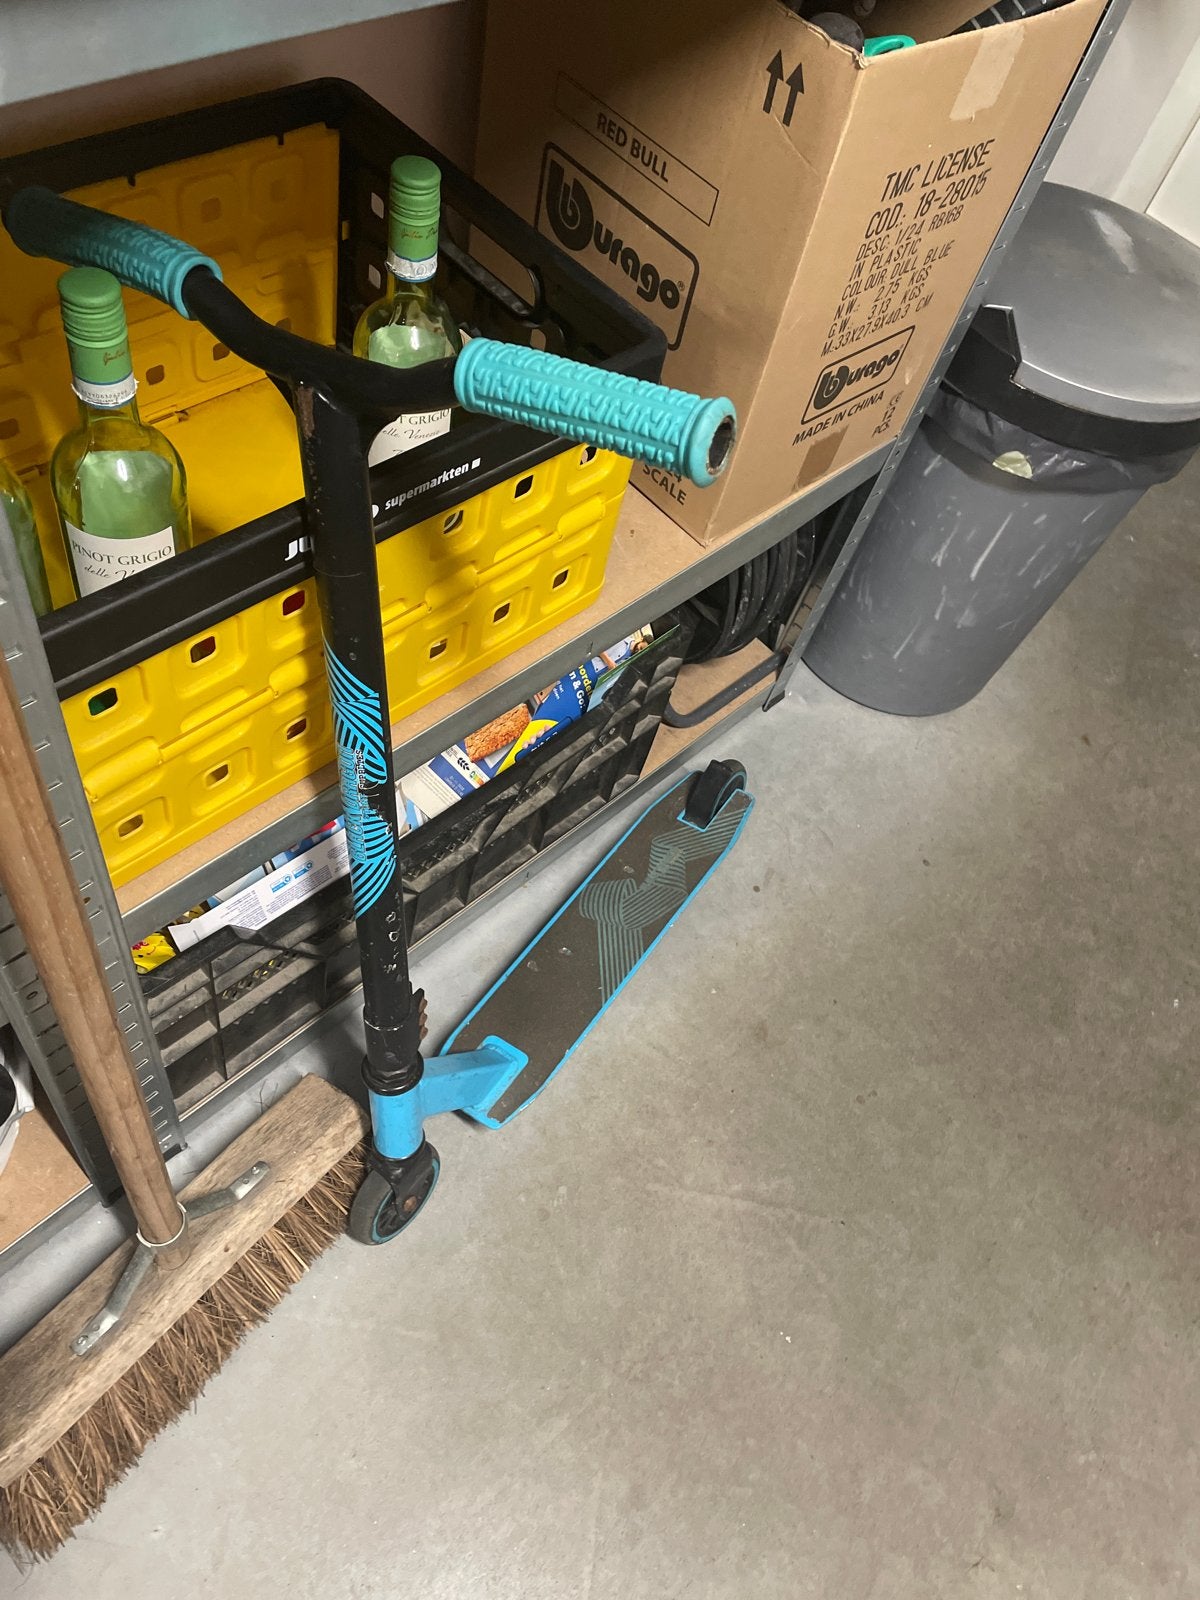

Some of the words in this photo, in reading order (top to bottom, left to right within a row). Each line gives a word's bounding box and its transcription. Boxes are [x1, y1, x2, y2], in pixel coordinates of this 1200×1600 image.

[596, 112, 628, 148] RED
[629, 137, 669, 183] BULL
[880, 164, 921, 202] TMC
[920, 138, 996, 189] LICENSE
[914, 167, 992, 220] 18-28015
[895, 219, 925, 246] 1/24
[849, 260, 865, 282] IN
[869, 238, 922, 273] PLASTIC
[890, 255, 918, 280] DULL
[923, 239, 956, 266] BLUE
[868, 298, 892, 321] 3.13
[901, 282, 925, 305] KGS
[874, 277, 903, 303] 2.75
[908, 264, 932, 287] KGS
[915, 291, 935, 313] CM
[382, 427, 400, 438] elle
[408, 408, 450, 425] GRIGIO
[791, 416, 832, 446] MADE
[831, 407, 847, 426] IN
[847, 389, 885, 418] CHINA
[881, 406, 896, 422] 12
[384, 461, 470, 511] supermarkten
[72, 540, 114, 564] PINOT
[117, 545, 173, 566] GRIGIO
[84, 564, 111, 578] delle
